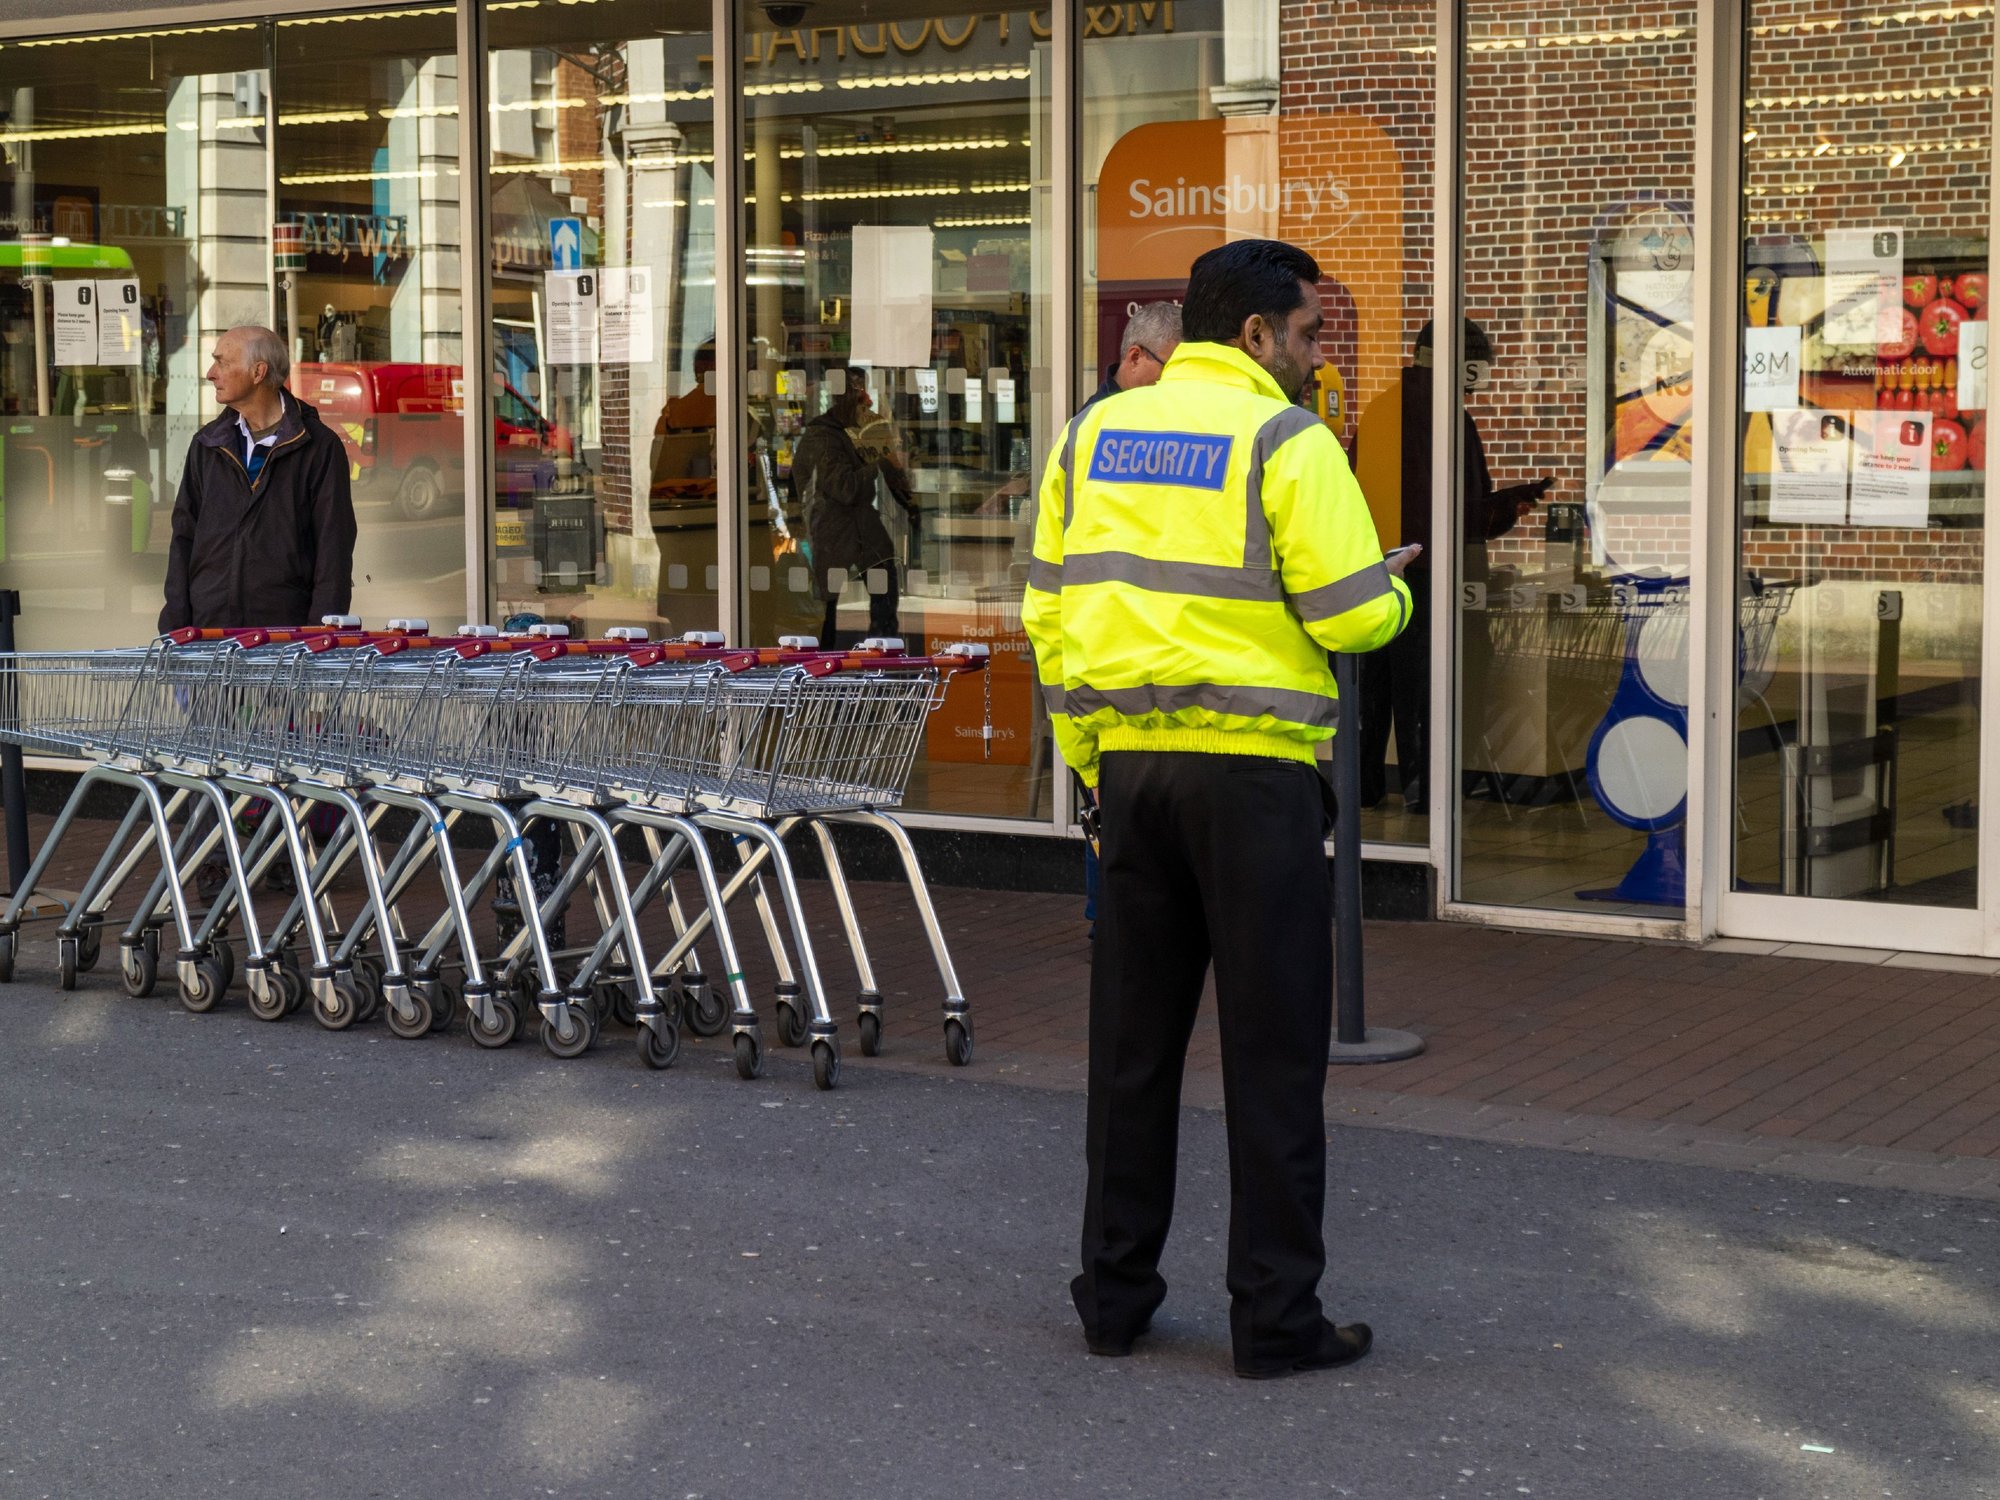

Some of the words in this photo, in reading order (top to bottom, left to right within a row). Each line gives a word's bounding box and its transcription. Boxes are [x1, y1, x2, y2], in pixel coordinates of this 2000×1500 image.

[1129, 171, 1350, 220] Sainsbury's
[1843, 364, 1906, 376] Automatic
[1909, 364, 1938, 376] door
[1779, 446, 1808, 454] Opening
[1098, 438, 1224, 480] SECURITY
[1880, 453, 1895, 461] keep
[962, 624, 995, 637] Food
